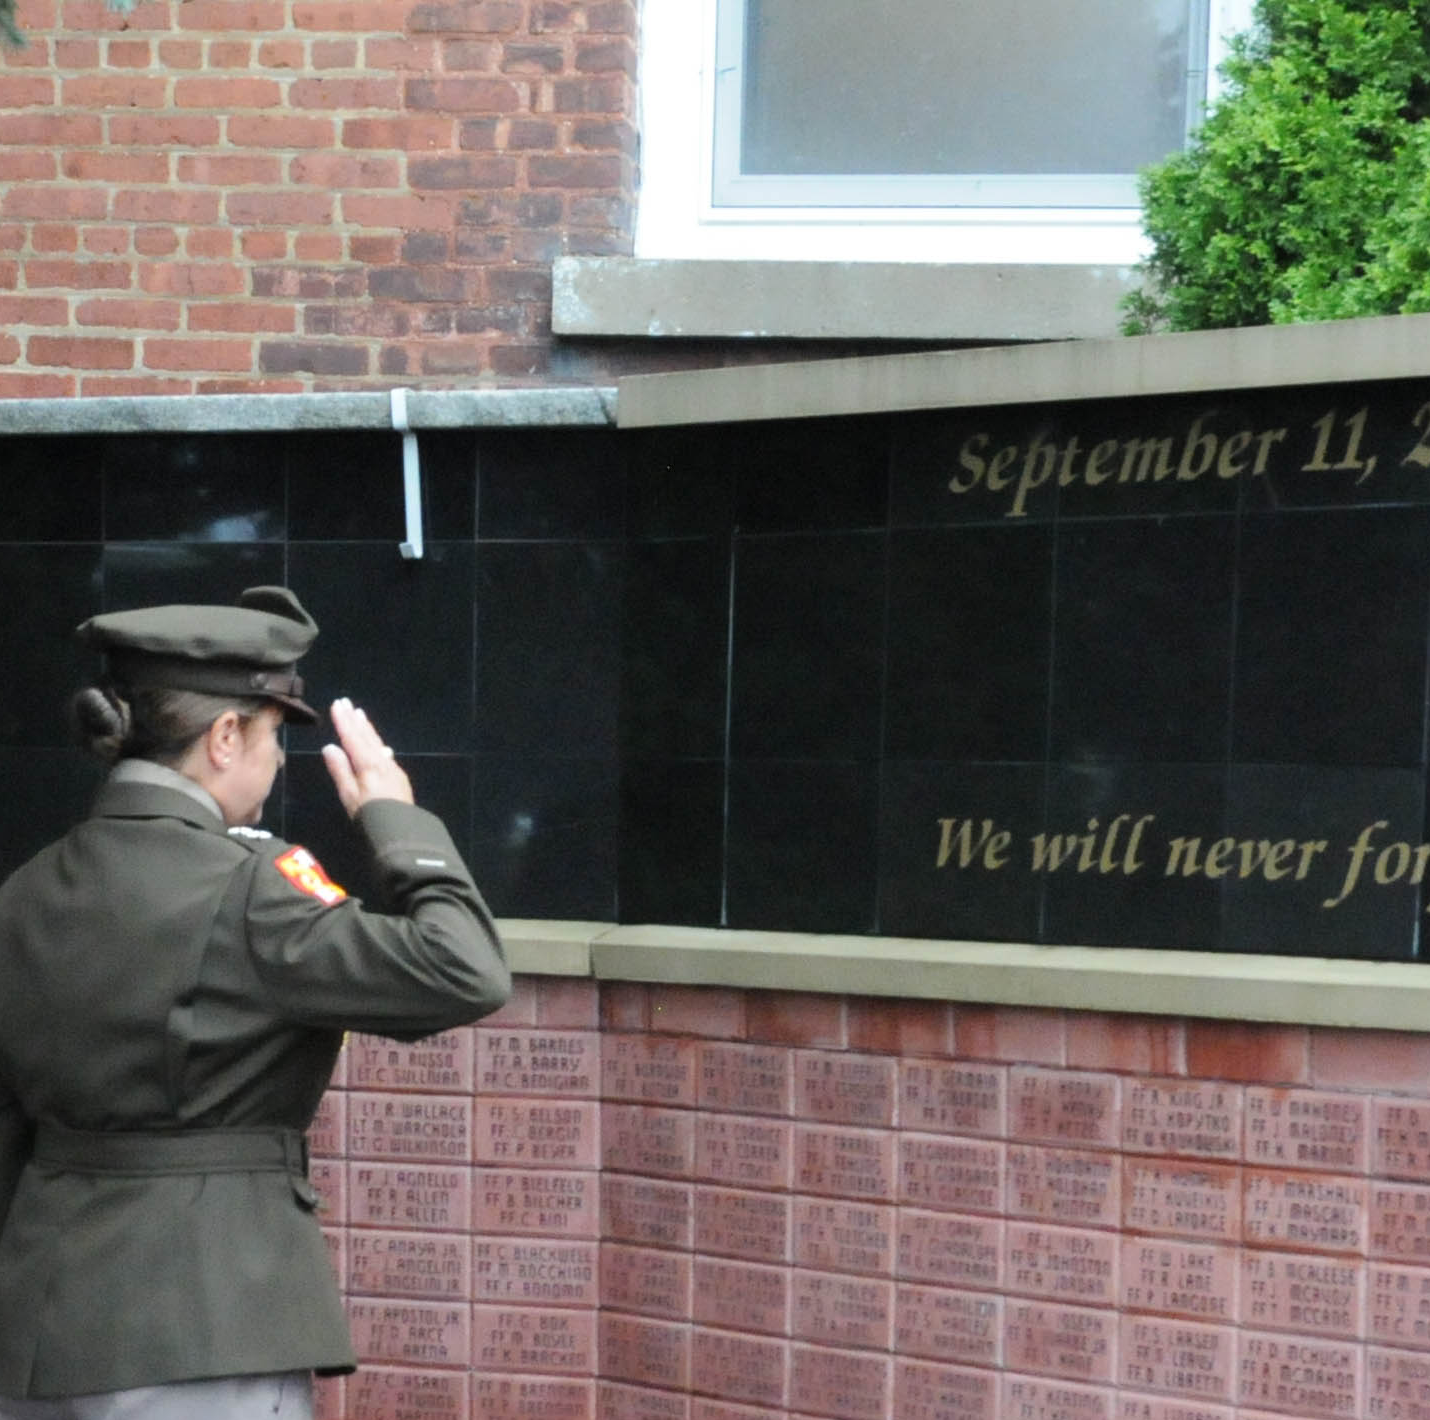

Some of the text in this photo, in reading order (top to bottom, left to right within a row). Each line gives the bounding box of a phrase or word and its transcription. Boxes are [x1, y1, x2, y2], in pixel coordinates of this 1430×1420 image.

[948, 416, 1286, 517] September
[1301, 406, 1377, 485] 11,
[936, 817, 1011, 871] We
[1031, 814, 1156, 874] will
[1165, 836, 1328, 881] never
